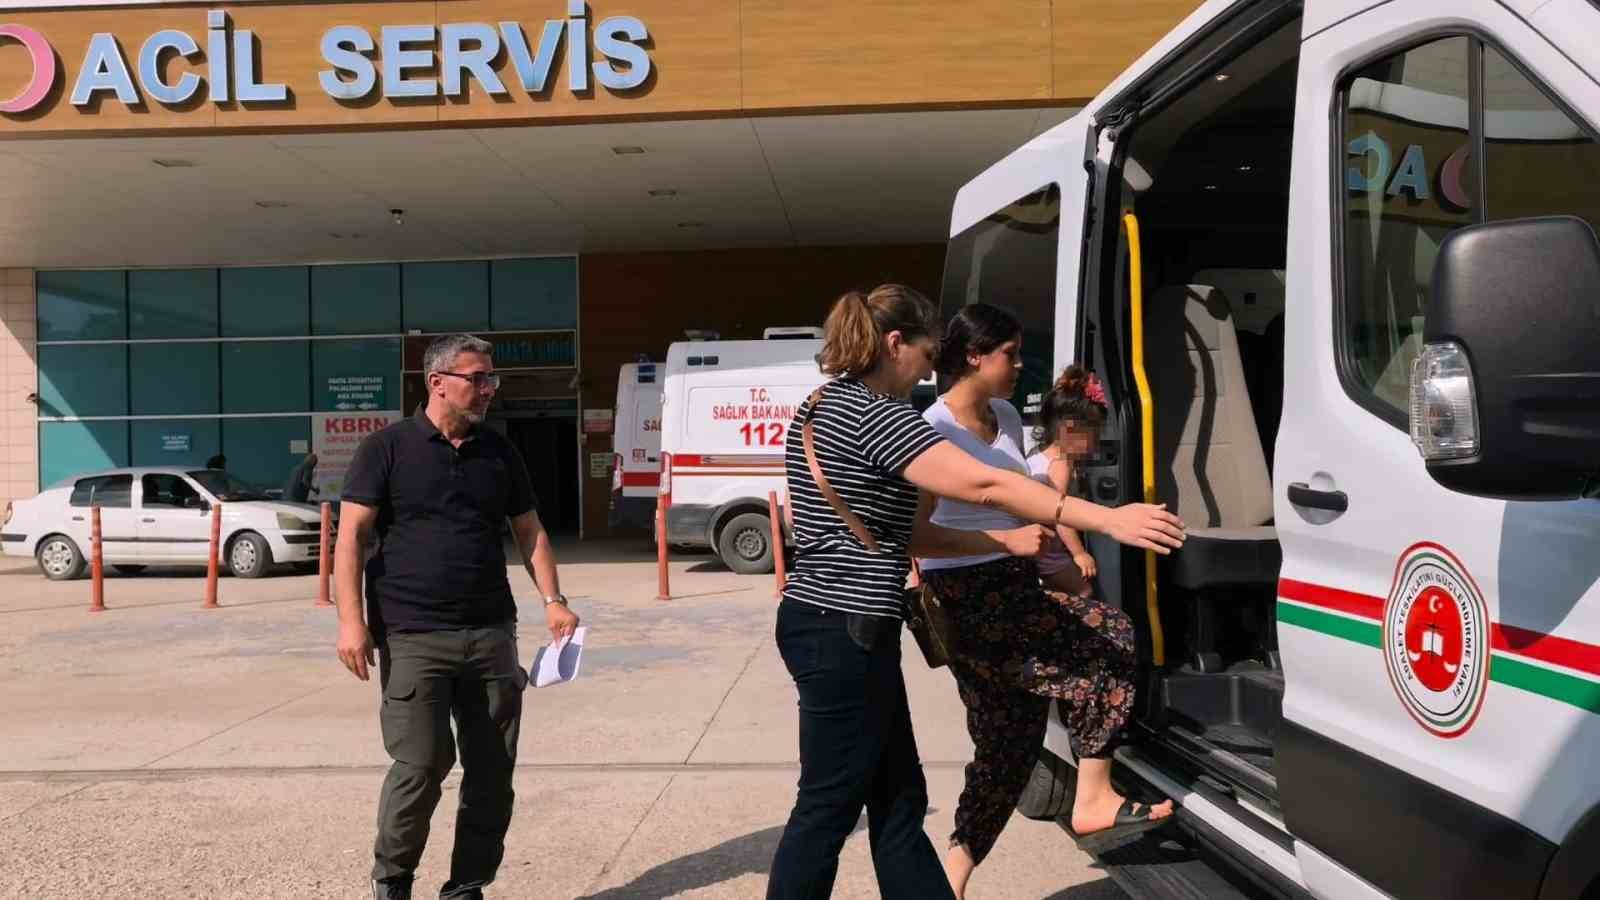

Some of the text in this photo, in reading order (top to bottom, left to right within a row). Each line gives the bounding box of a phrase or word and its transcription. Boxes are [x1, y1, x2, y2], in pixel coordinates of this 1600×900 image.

[70, 0, 651, 105] ACİL SERVİS
[750, 388, 770, 402] T.C.
[712, 403, 797, 420] SAĞLIK BAKANLI
[325, 417, 389, 433] KBRN
[740, 422, 784, 446] 112
